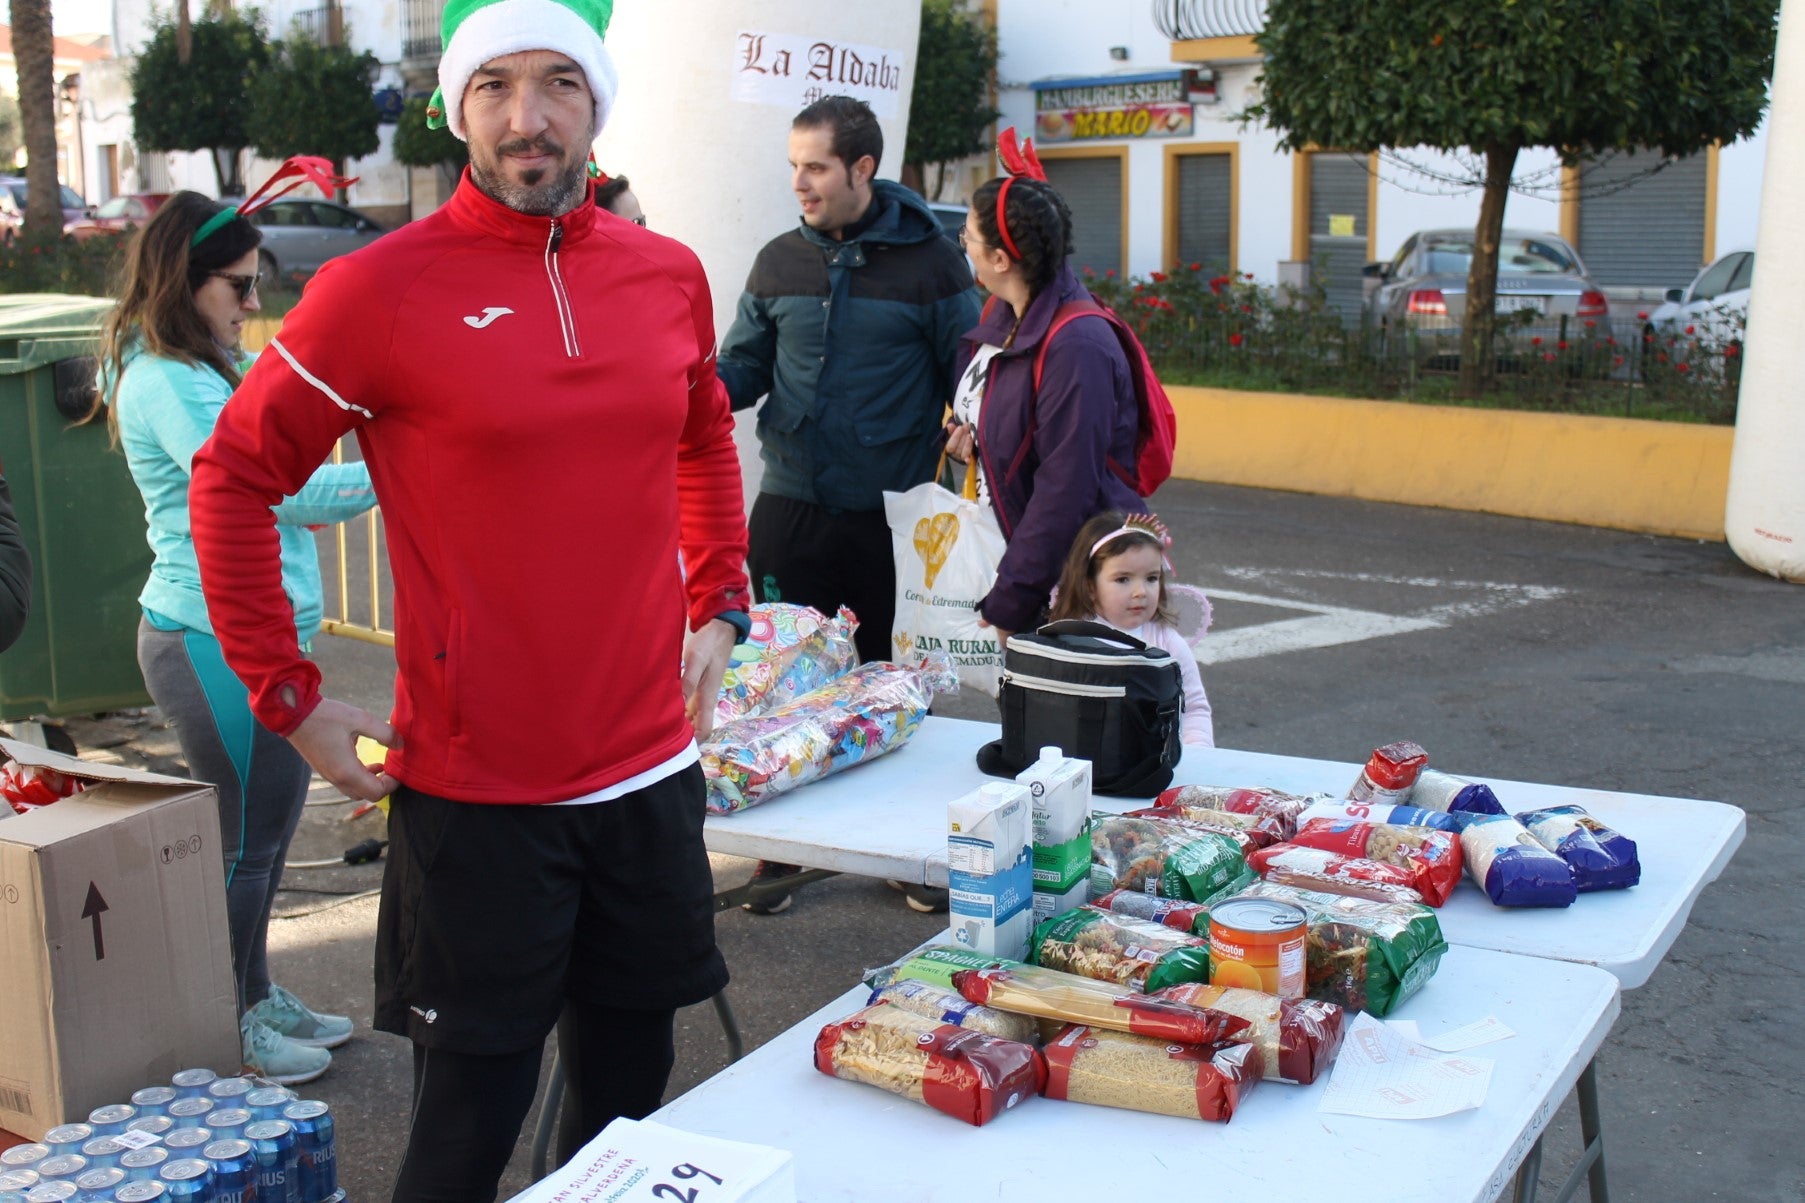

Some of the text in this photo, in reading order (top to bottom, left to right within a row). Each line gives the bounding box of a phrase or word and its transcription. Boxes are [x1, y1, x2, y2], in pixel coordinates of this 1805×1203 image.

[739, 33, 901, 91] La Aldaba
[1072, 108, 1151, 138] MARIO
[947, 639, 1001, 655] RURAL
[996, 893, 1020, 916] ENTERA
[569, 1148, 619, 1189] SILVESTRE
[651, 1162, 724, 1203] 29
